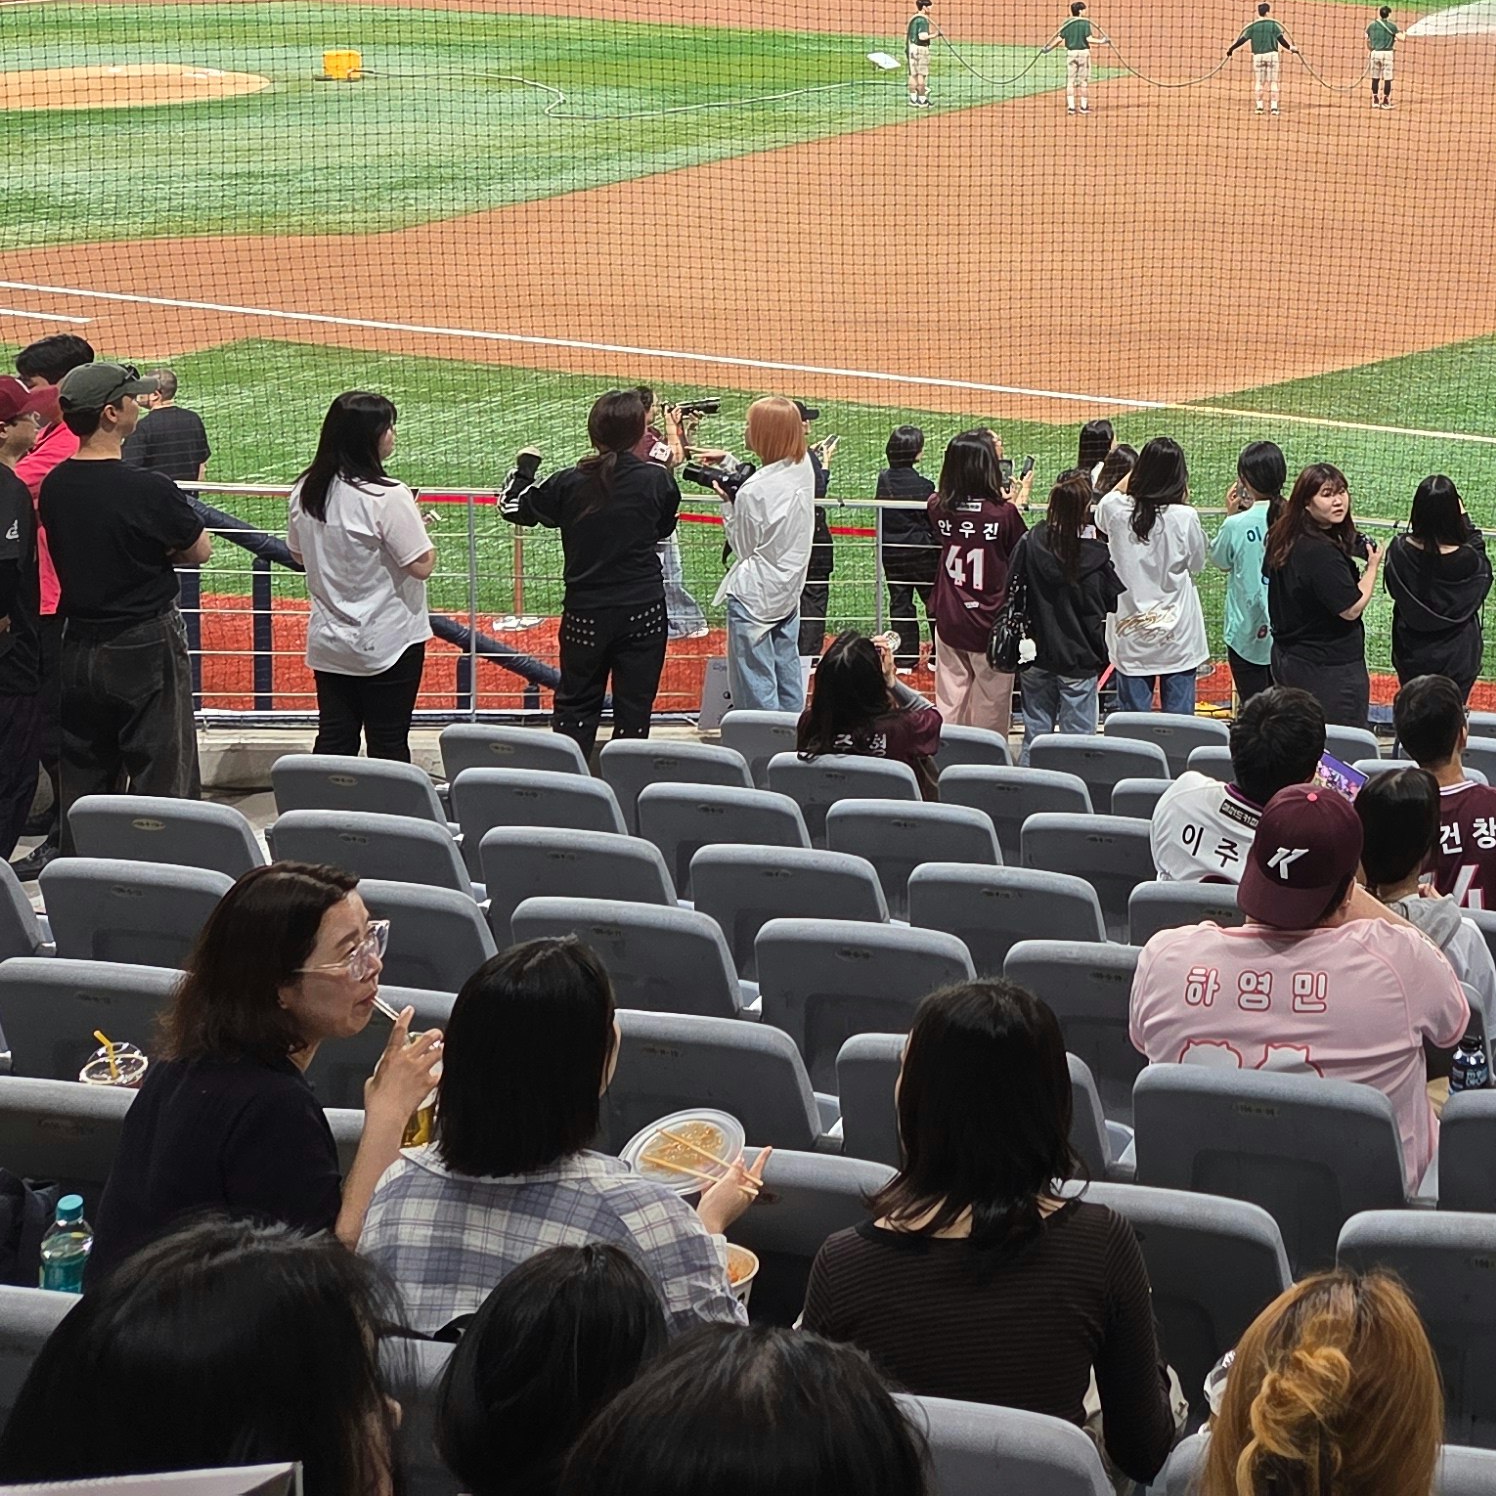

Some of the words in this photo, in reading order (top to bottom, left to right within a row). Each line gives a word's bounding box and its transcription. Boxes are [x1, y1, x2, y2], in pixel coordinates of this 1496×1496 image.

[938, 519, 999, 541] 안우진
[945, 545, 984, 590] 41
[1182, 823, 1239, 868] 이주
[1266, 846, 1310, 880] K
[1184, 965, 1328, 1013] 하영민
